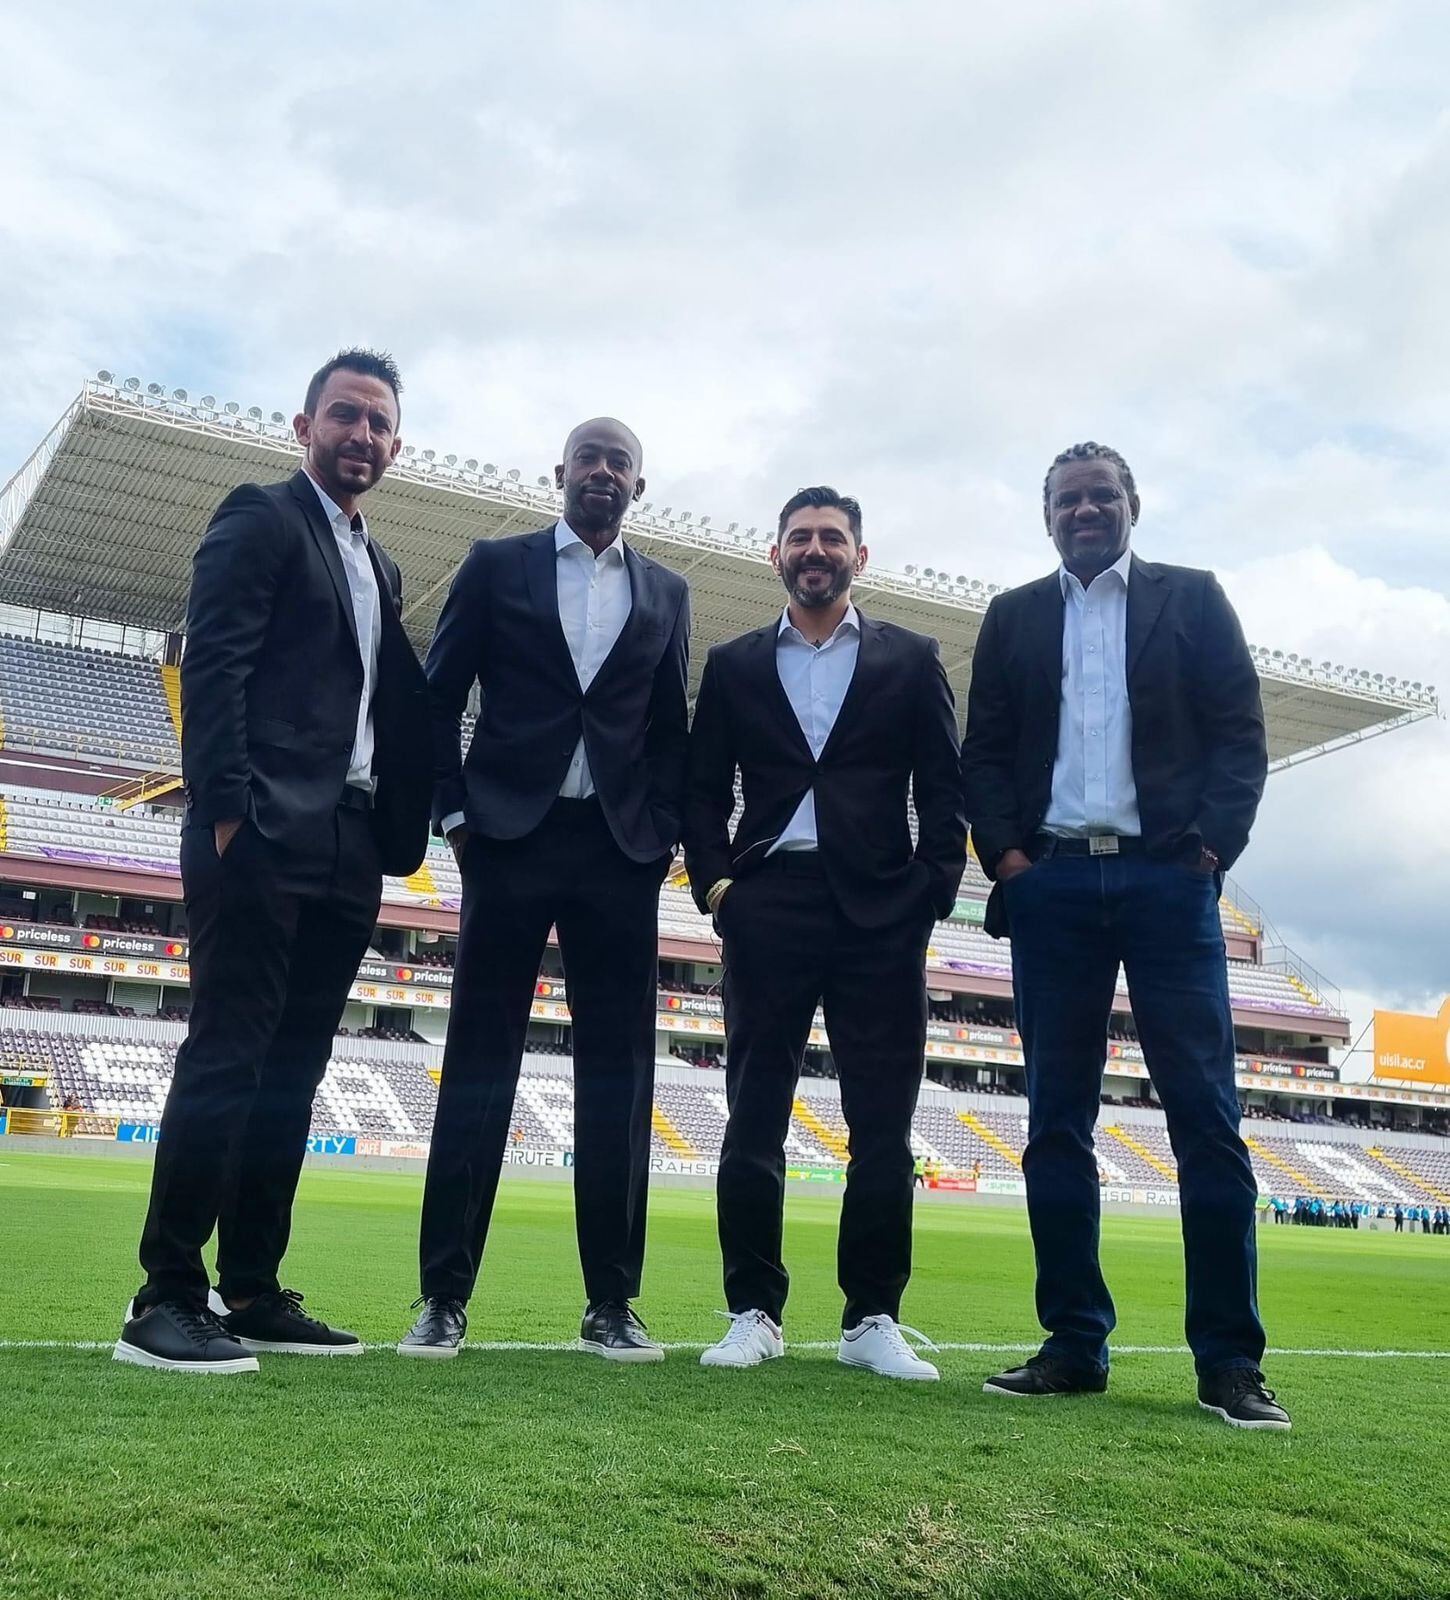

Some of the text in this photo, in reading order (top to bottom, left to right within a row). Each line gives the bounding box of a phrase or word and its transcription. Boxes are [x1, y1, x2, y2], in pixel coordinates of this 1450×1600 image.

[17, 928, 71, 943] priceless
[102, 938, 155, 952] priceless
[0, 952, 22, 963] SUR
[34, 955, 57, 966] SUR
[69, 958, 92, 969] SUR
[104, 961, 126, 973] SUR
[137, 964, 158, 976] SUR
[356, 987, 376, 998] SUR
[386, 990, 406, 1001] SUR
[415, 992, 434, 1004] SUR
